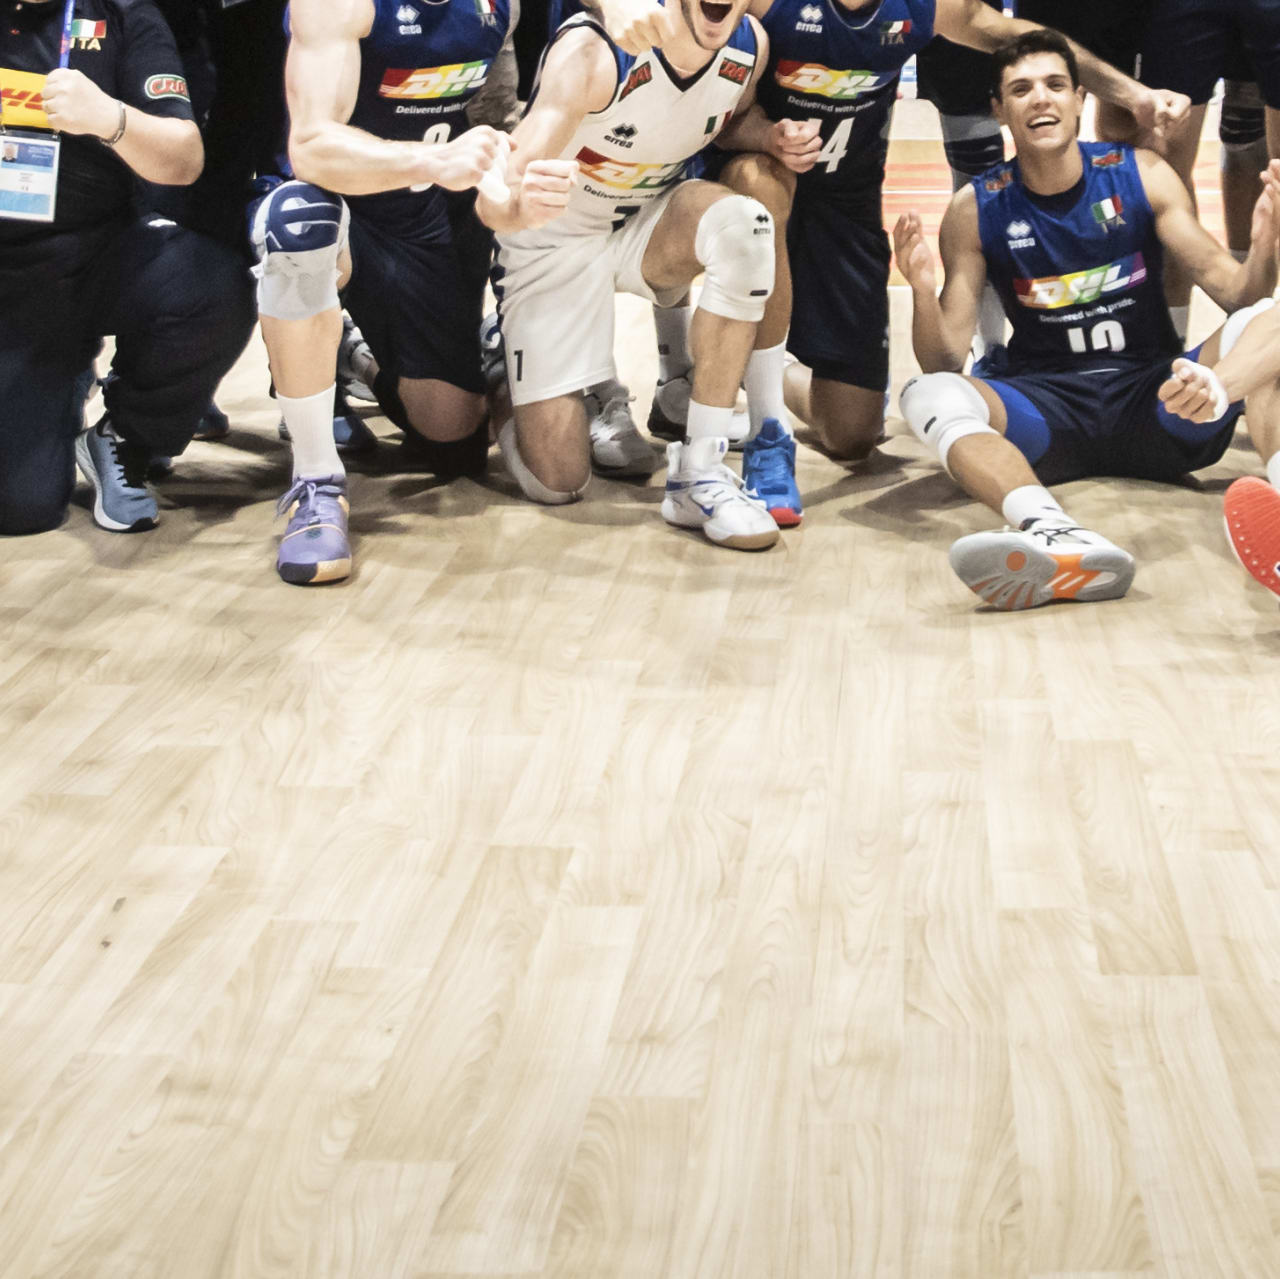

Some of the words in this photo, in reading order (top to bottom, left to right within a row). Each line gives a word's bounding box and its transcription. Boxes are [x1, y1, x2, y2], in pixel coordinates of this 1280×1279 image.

[795, 20, 823, 34] errea
[69, 37, 101, 51] ITA
[880, 34, 905, 46] ITA
[401, 63, 488, 95] DHL
[791, 67, 885, 96] DHL
[396, 105, 442, 115] Delivered
[787, 95, 834, 112] Delivered
[603, 134, 634, 149] errea
[809, 117, 856, 174] 4
[1032, 265, 1131, 304] DHL
